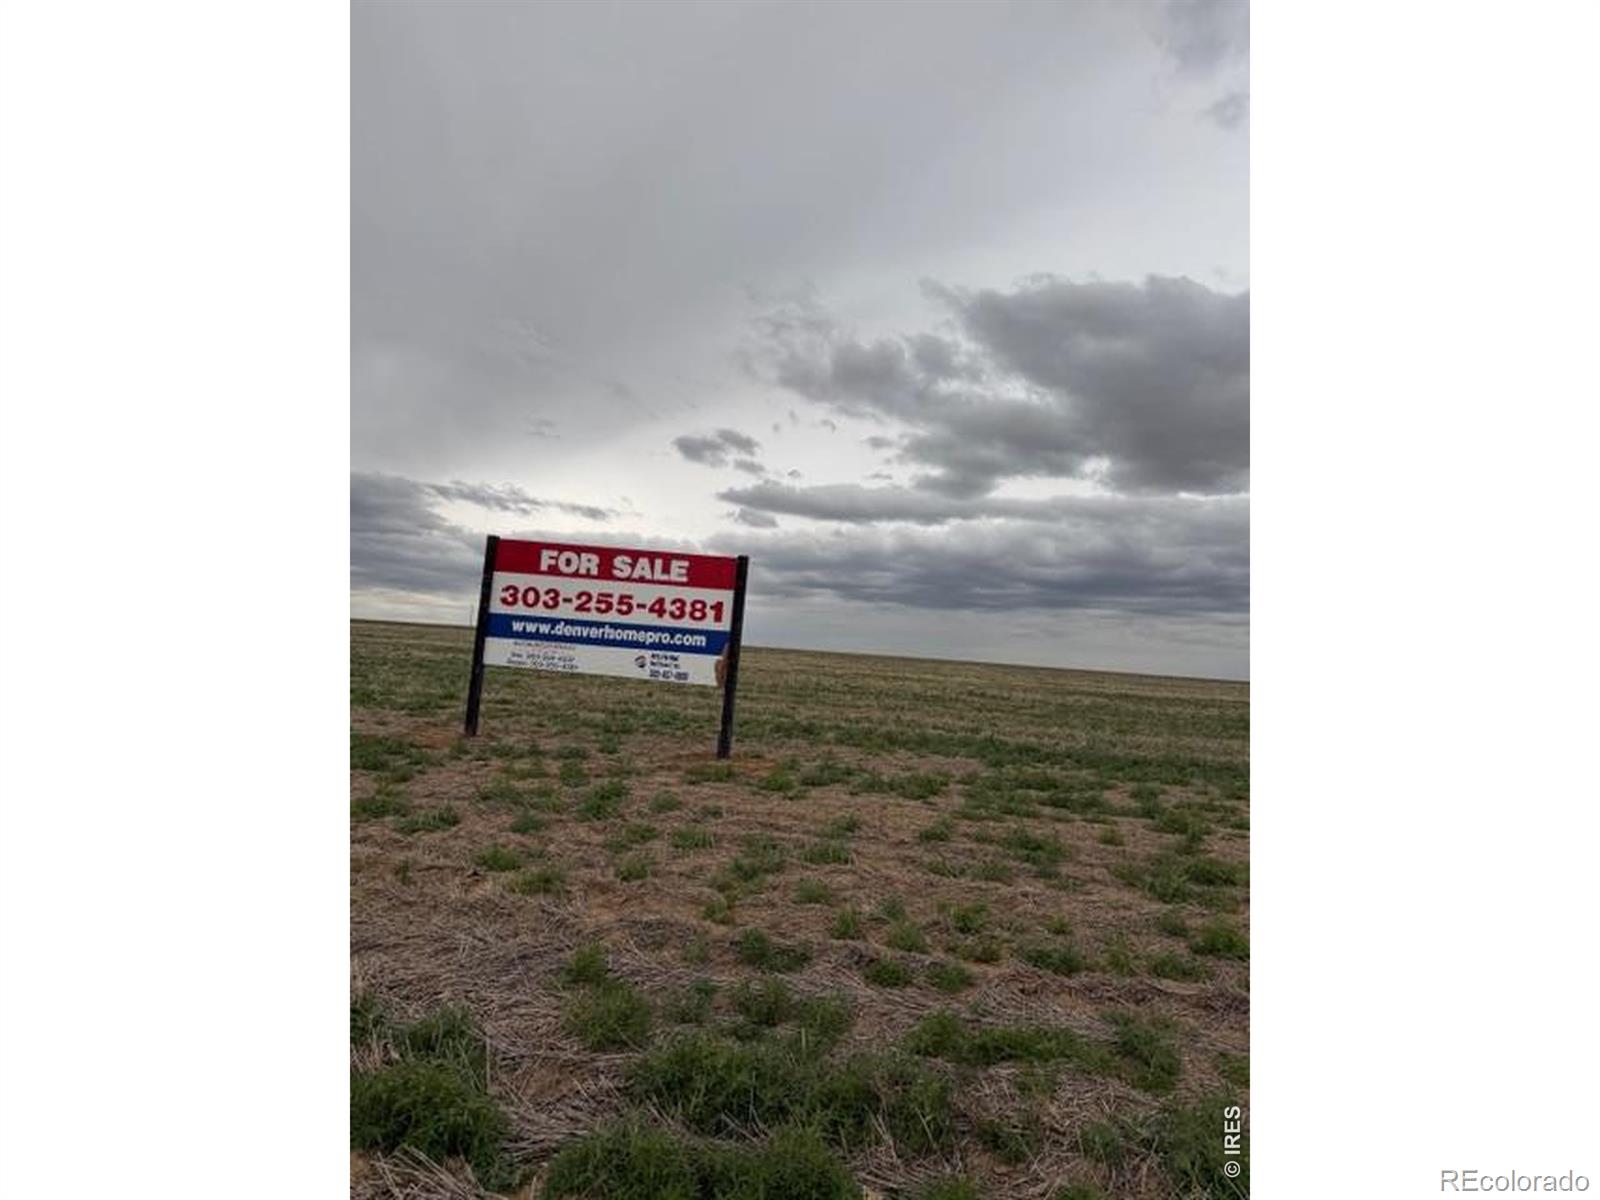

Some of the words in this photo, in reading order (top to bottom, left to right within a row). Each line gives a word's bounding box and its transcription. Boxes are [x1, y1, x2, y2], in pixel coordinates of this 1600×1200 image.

[539, 549, 599, 576] FOR
[612, 555, 690, 582] SALE
[500, 585, 724, 623] 303-255-4381
[512, 621, 707, 647] www.denverhomepro.com
